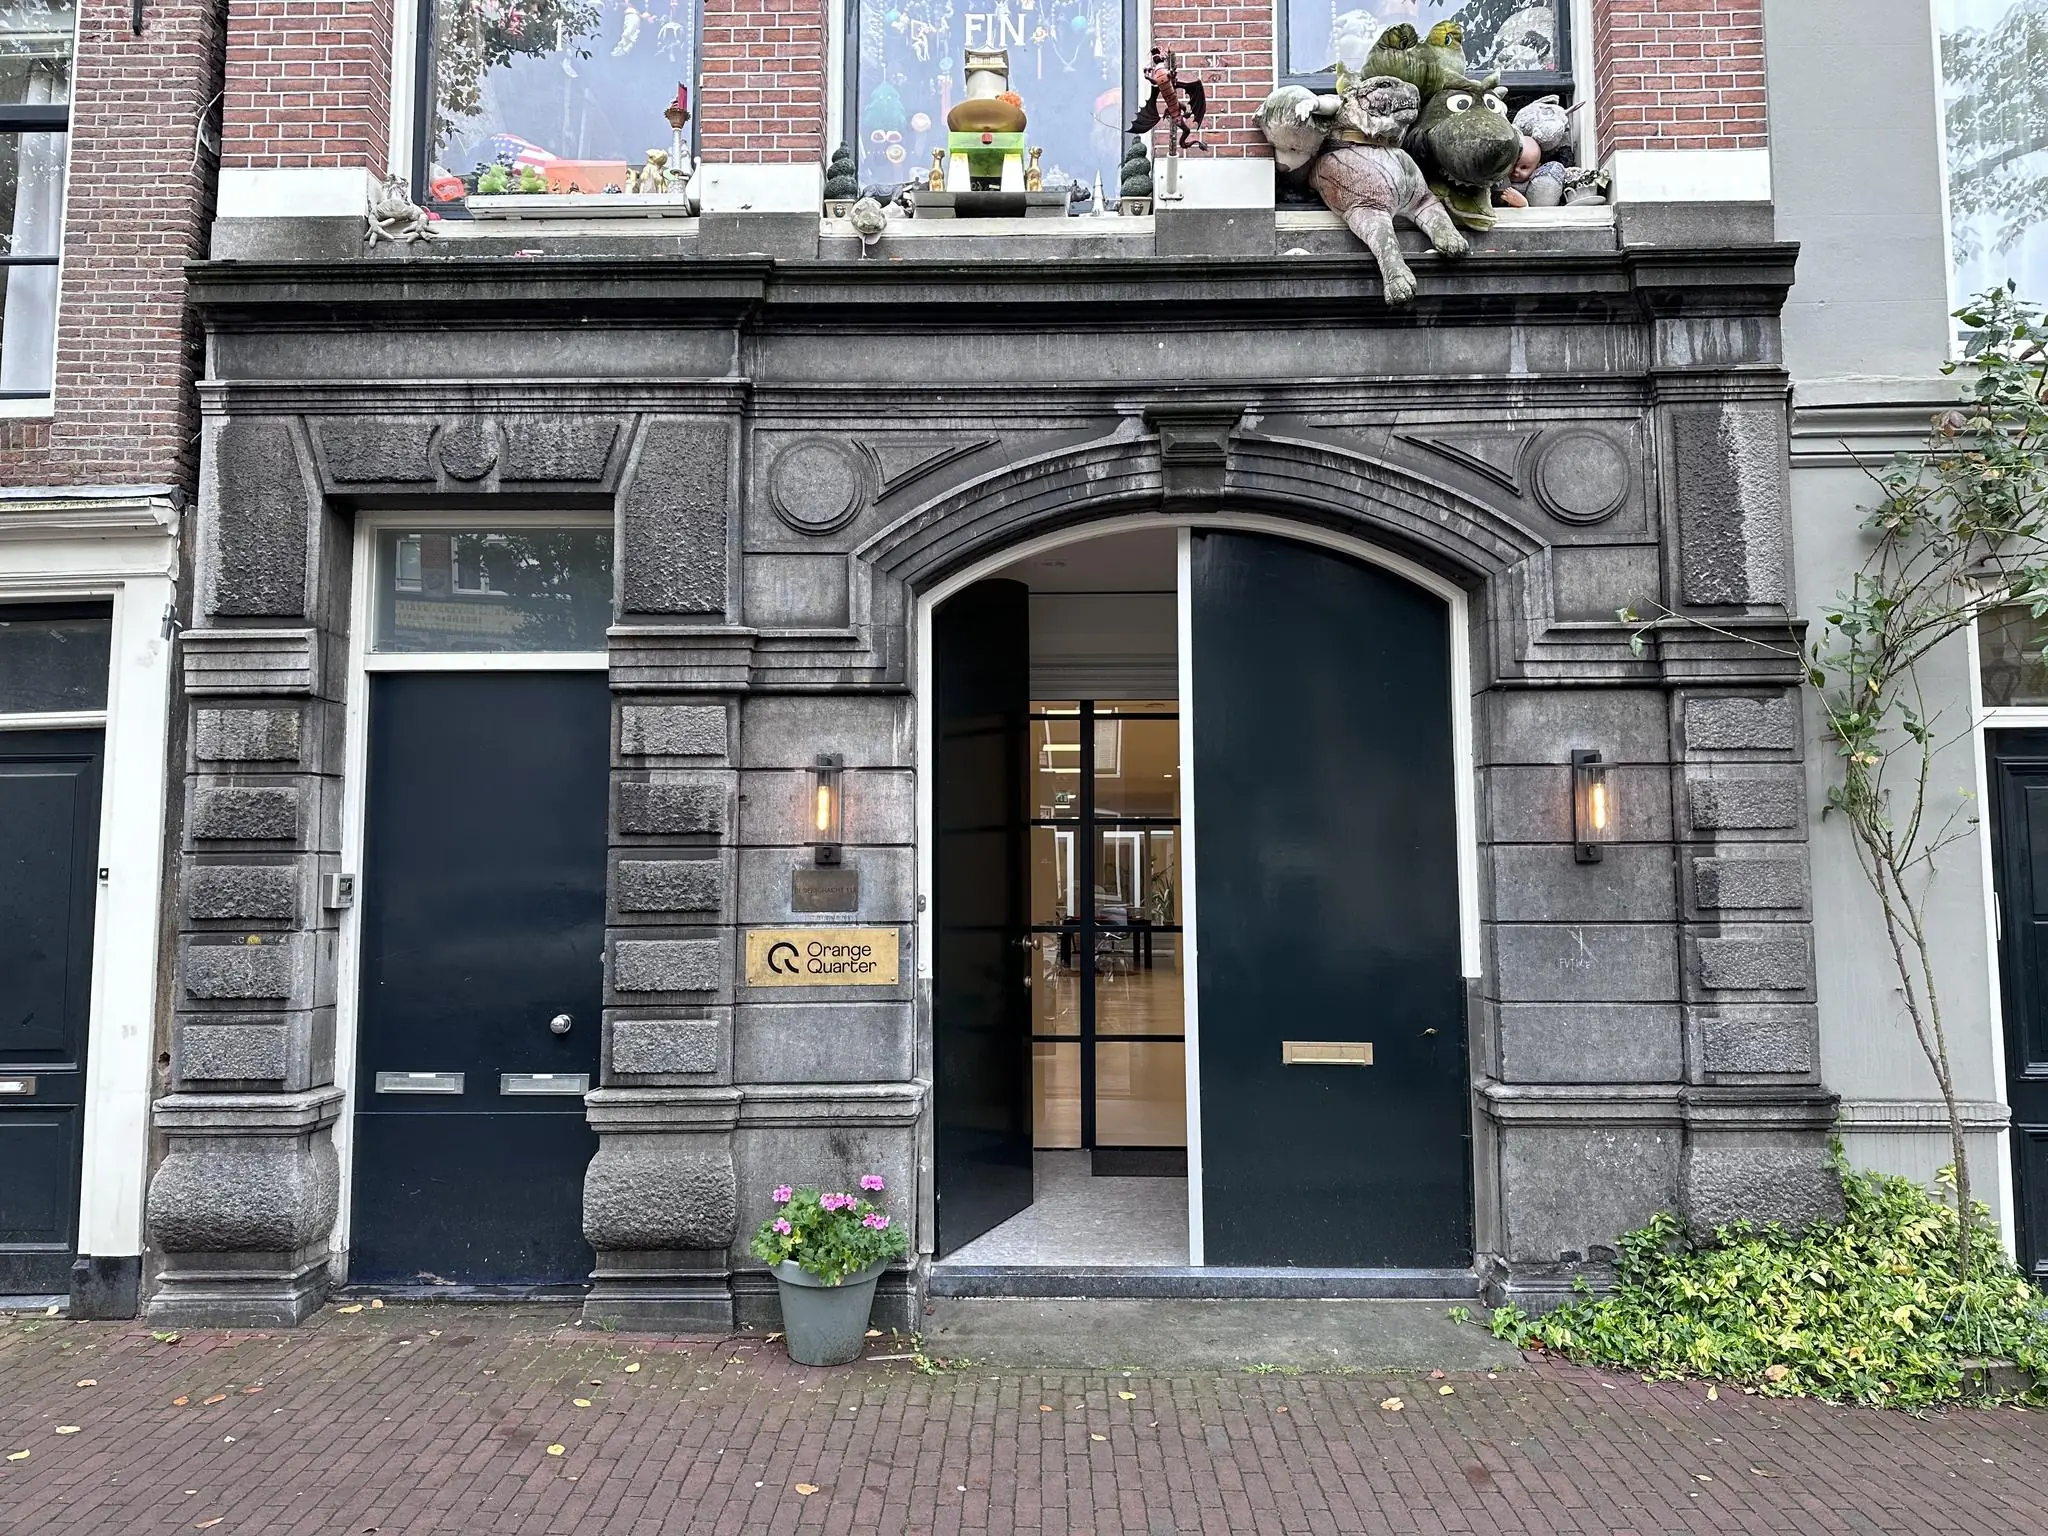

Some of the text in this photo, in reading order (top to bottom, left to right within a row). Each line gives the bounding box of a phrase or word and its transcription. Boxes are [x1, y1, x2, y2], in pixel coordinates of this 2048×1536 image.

[964, 13, 1027, 46] FIN
[807, 941, 872, 961] Orange
[807, 958, 877, 974] Quarter
